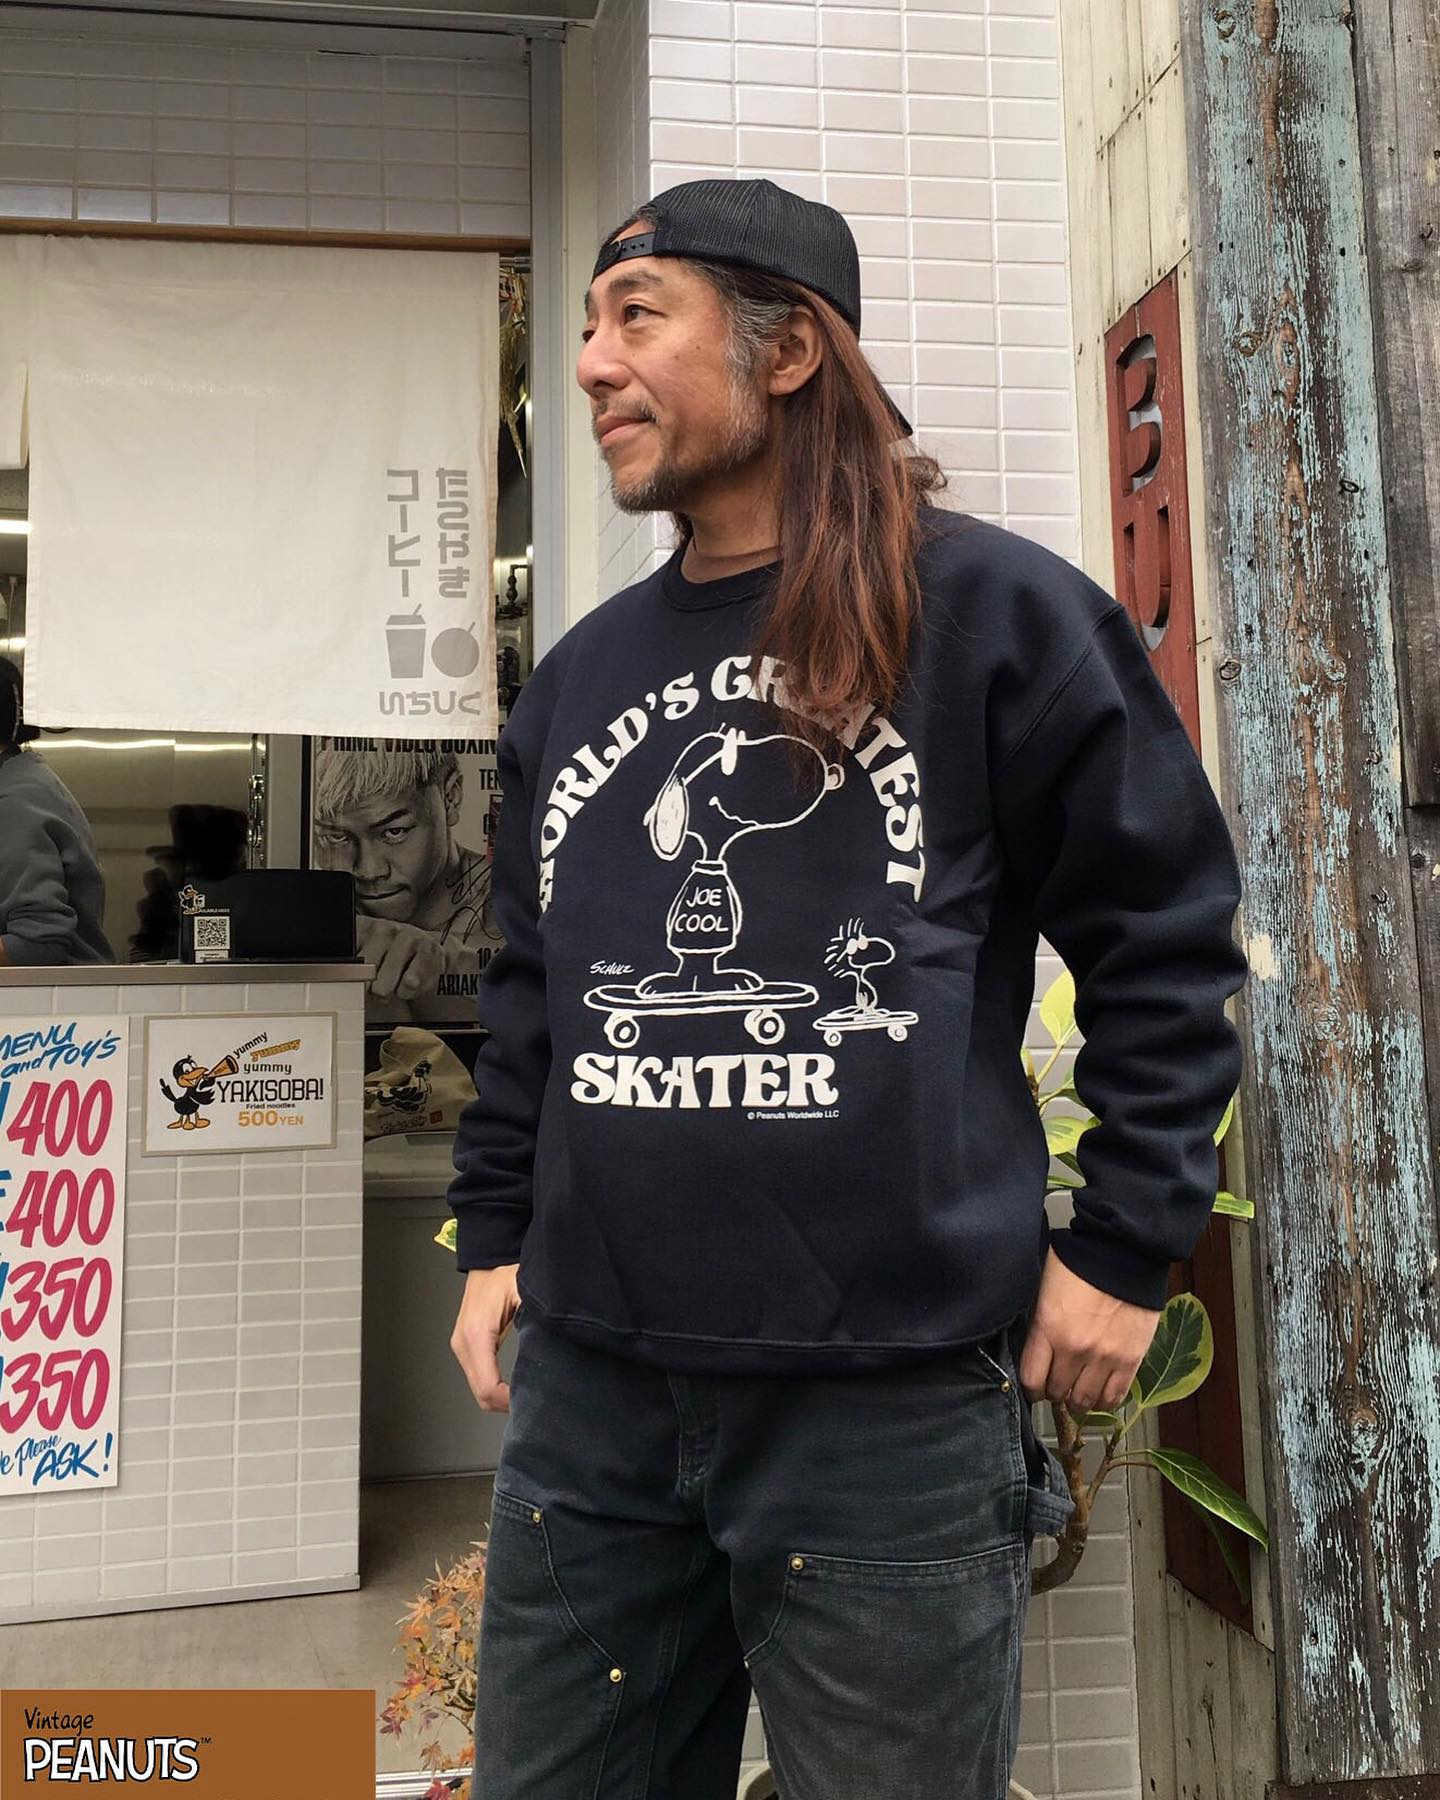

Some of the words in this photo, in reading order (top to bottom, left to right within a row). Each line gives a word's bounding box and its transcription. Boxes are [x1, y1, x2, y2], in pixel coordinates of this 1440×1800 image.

[387, 469, 421, 597] コーヒー
[435, 467, 470, 598] たこやき
[686, 886, 722, 907] JOE
[675, 913, 729, 932] COOL
[437, 974, 482, 996] ARIAK
[1, 1054, 47, 1079] and
[233, 1032, 268, 1059] yummy
[243, 1062, 292, 1075] yummy
[570, 1052, 840, 1108] SKATER
[216, 1078, 324, 1103] YAKISOBA!
[6, 1079, 113, 1157] 400
[756, 1111, 786, 1119] Peanuts
[787, 1110, 823, 1119] Worldwide
[825, 1109, 840, 1118] LLC
[5, 1168, 115, 1248] 400
[1, 1257, 112, 1342] 350
[0, 1348, 110, 1434] 350
[15, 1435, 61, 1477] Please
[32, 1432, 113, 1486] ASK!
